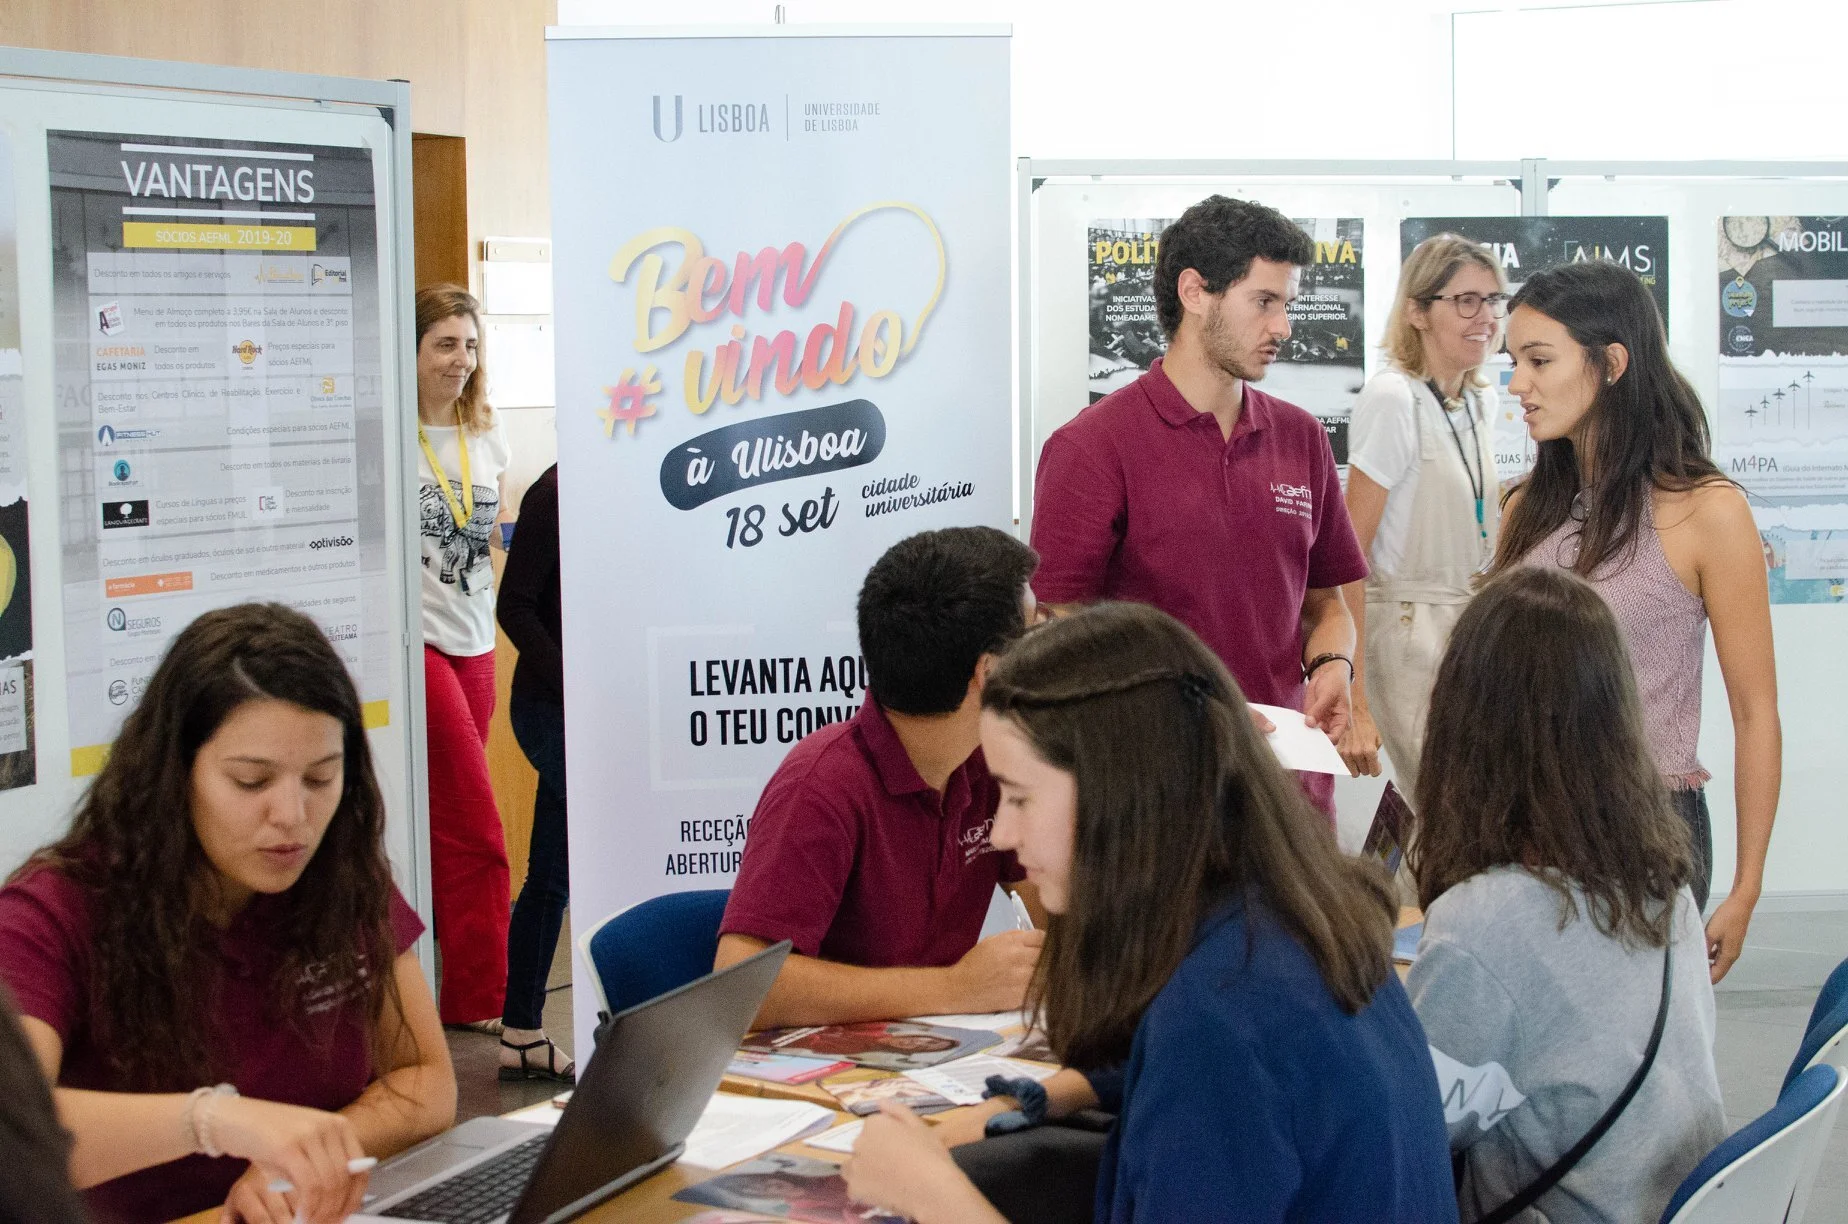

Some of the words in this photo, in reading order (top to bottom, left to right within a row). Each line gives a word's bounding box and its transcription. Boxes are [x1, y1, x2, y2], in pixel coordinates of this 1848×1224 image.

[804, 101, 881, 116] UNIVERSIDADE
[652, 94, 683, 143] U
[698, 103, 771, 133] LISBOA
[804, 119, 818, 132] DE
[821, 118, 859, 132] LISBOA
[121, 160, 315, 203] VANTAGENS
[237, 229, 293, 245] 2019-20
[1779, 231, 1848, 253] MOBIL
[1315, 240, 1357, 264] IVA
[142, 270, 161, 278] todos
[608, 226, 815, 353] Bem
[1112, 295, 1157, 303] INICIATIVAS
[1297, 294, 1339, 302] INTERESSE
[133, 307, 153, 316] Menu
[155, 307, 164, 315] de
[166, 307, 192, 317] Almoço
[194, 307, 225, 317] completo
[263, 307, 278, 315] Sala
[280, 307, 288, 315] de
[289, 307, 313, 315] Alunos
[1307, 313, 1348, 321] SUPERIOR.
[167, 320, 187, 328] todos
[198, 320, 228, 329] produtos
[242, 319, 261, 328] Bares
[271, 319, 286, 327] Sala
[287, 319, 296, 327] de
[335, 319, 349, 328] piso
[96, 346, 146, 357] CAFETARIA
[153, 345, 186, 354] Desconto
[267, 342, 289, 351] Preços
[291, 342, 320, 351] especiais
[96, 362, 117, 371] EGAS
[120, 362, 146, 371] MONIZ
[154, 362, 174, 370] todos
[185, 362, 216, 371] produtos
[268, 358, 289, 366] sócios
[97, 392, 132, 401] Desconto
[151, 391, 179, 400] Centros
[209, 389, 218, 397] de
[98, 404, 137, 414] Bem-Estar
[226, 425, 261, 436] Condições
[262, 424, 291, 435] especiais
[292, 424, 307, 433] para
[220, 461, 252, 472] Desconto
[252, 462, 263, 470] em
[264, 459, 283, 469] todos
[322, 457, 331, 465] de
[685, 446, 716, 487] à
[1731, 454, 1778, 473] M4PA
[861, 472, 921, 499] cidade
[285, 488, 315, 498] Desconto
[865, 482, 976, 518] universitária
[155, 499, 180, 509] Cursos
[181, 497, 190, 507] de
[224, 495, 247, 506] preços
[189, 515, 204, 525] para
[205, 513, 226, 522] sócios
[725, 503, 767, 550] 18
[777, 486, 840, 538] set
[309, 535, 354, 551] optivisão
[236, 546, 245, 555] de
[210, 570, 243, 581] Desconto
[243, 569, 255, 578] em
[255, 565, 301, 577] medicamentos
[308, 563, 328, 571] outros
[328, 559, 356, 571] produtos
[127, 617, 162, 630] SEGUROS
[110, 656, 144, 667] Desconto
[689, 656, 813, 697] LEVANTA
[819, 655, 871, 699] AQU
[690, 710, 708, 747] O
[716, 708, 768, 746] TEU
[681, 814, 751, 847] RECEÇÃ
[665, 851, 743, 876] ABERTUR
